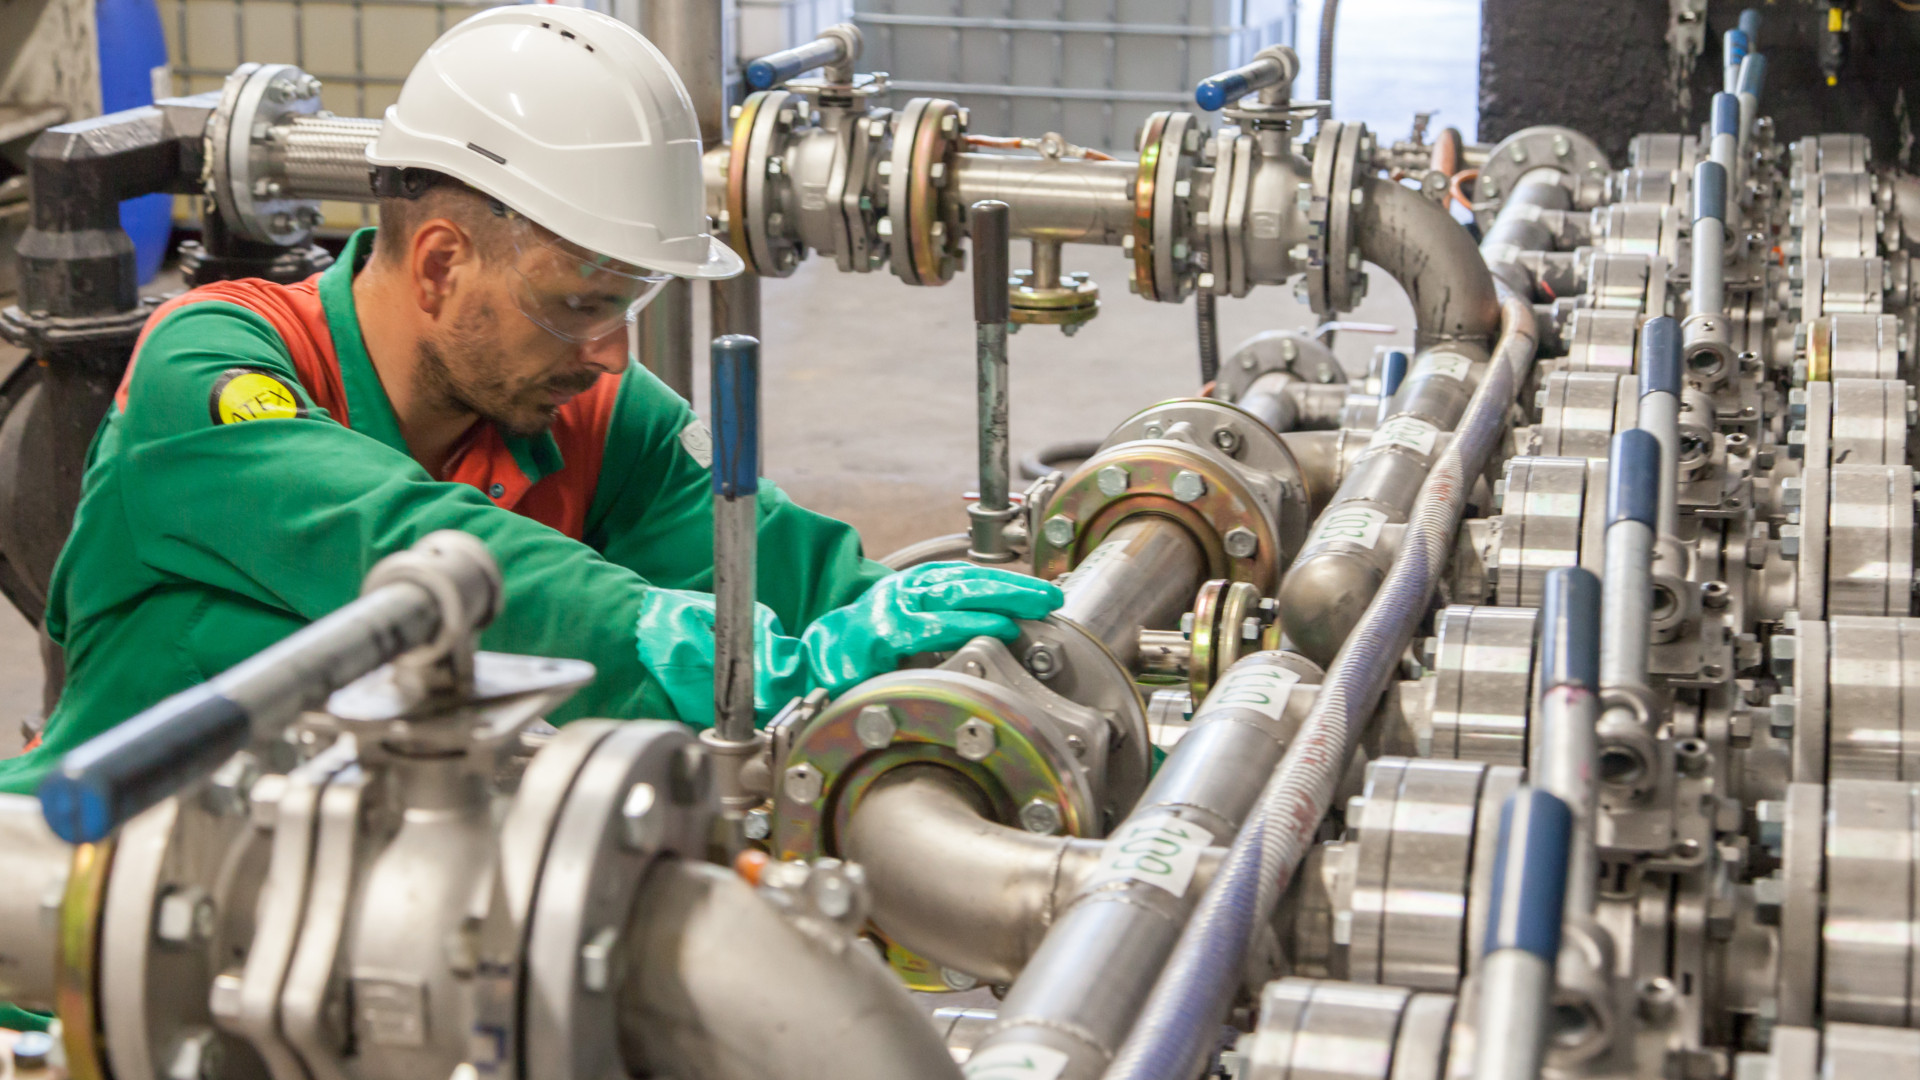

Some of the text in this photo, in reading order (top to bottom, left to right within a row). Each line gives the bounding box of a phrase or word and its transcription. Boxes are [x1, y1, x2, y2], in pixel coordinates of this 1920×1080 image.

[1319, 511, 1372, 539] 103
[1216, 670, 1282, 705] 110
[1111, 827, 1190, 876] 109
